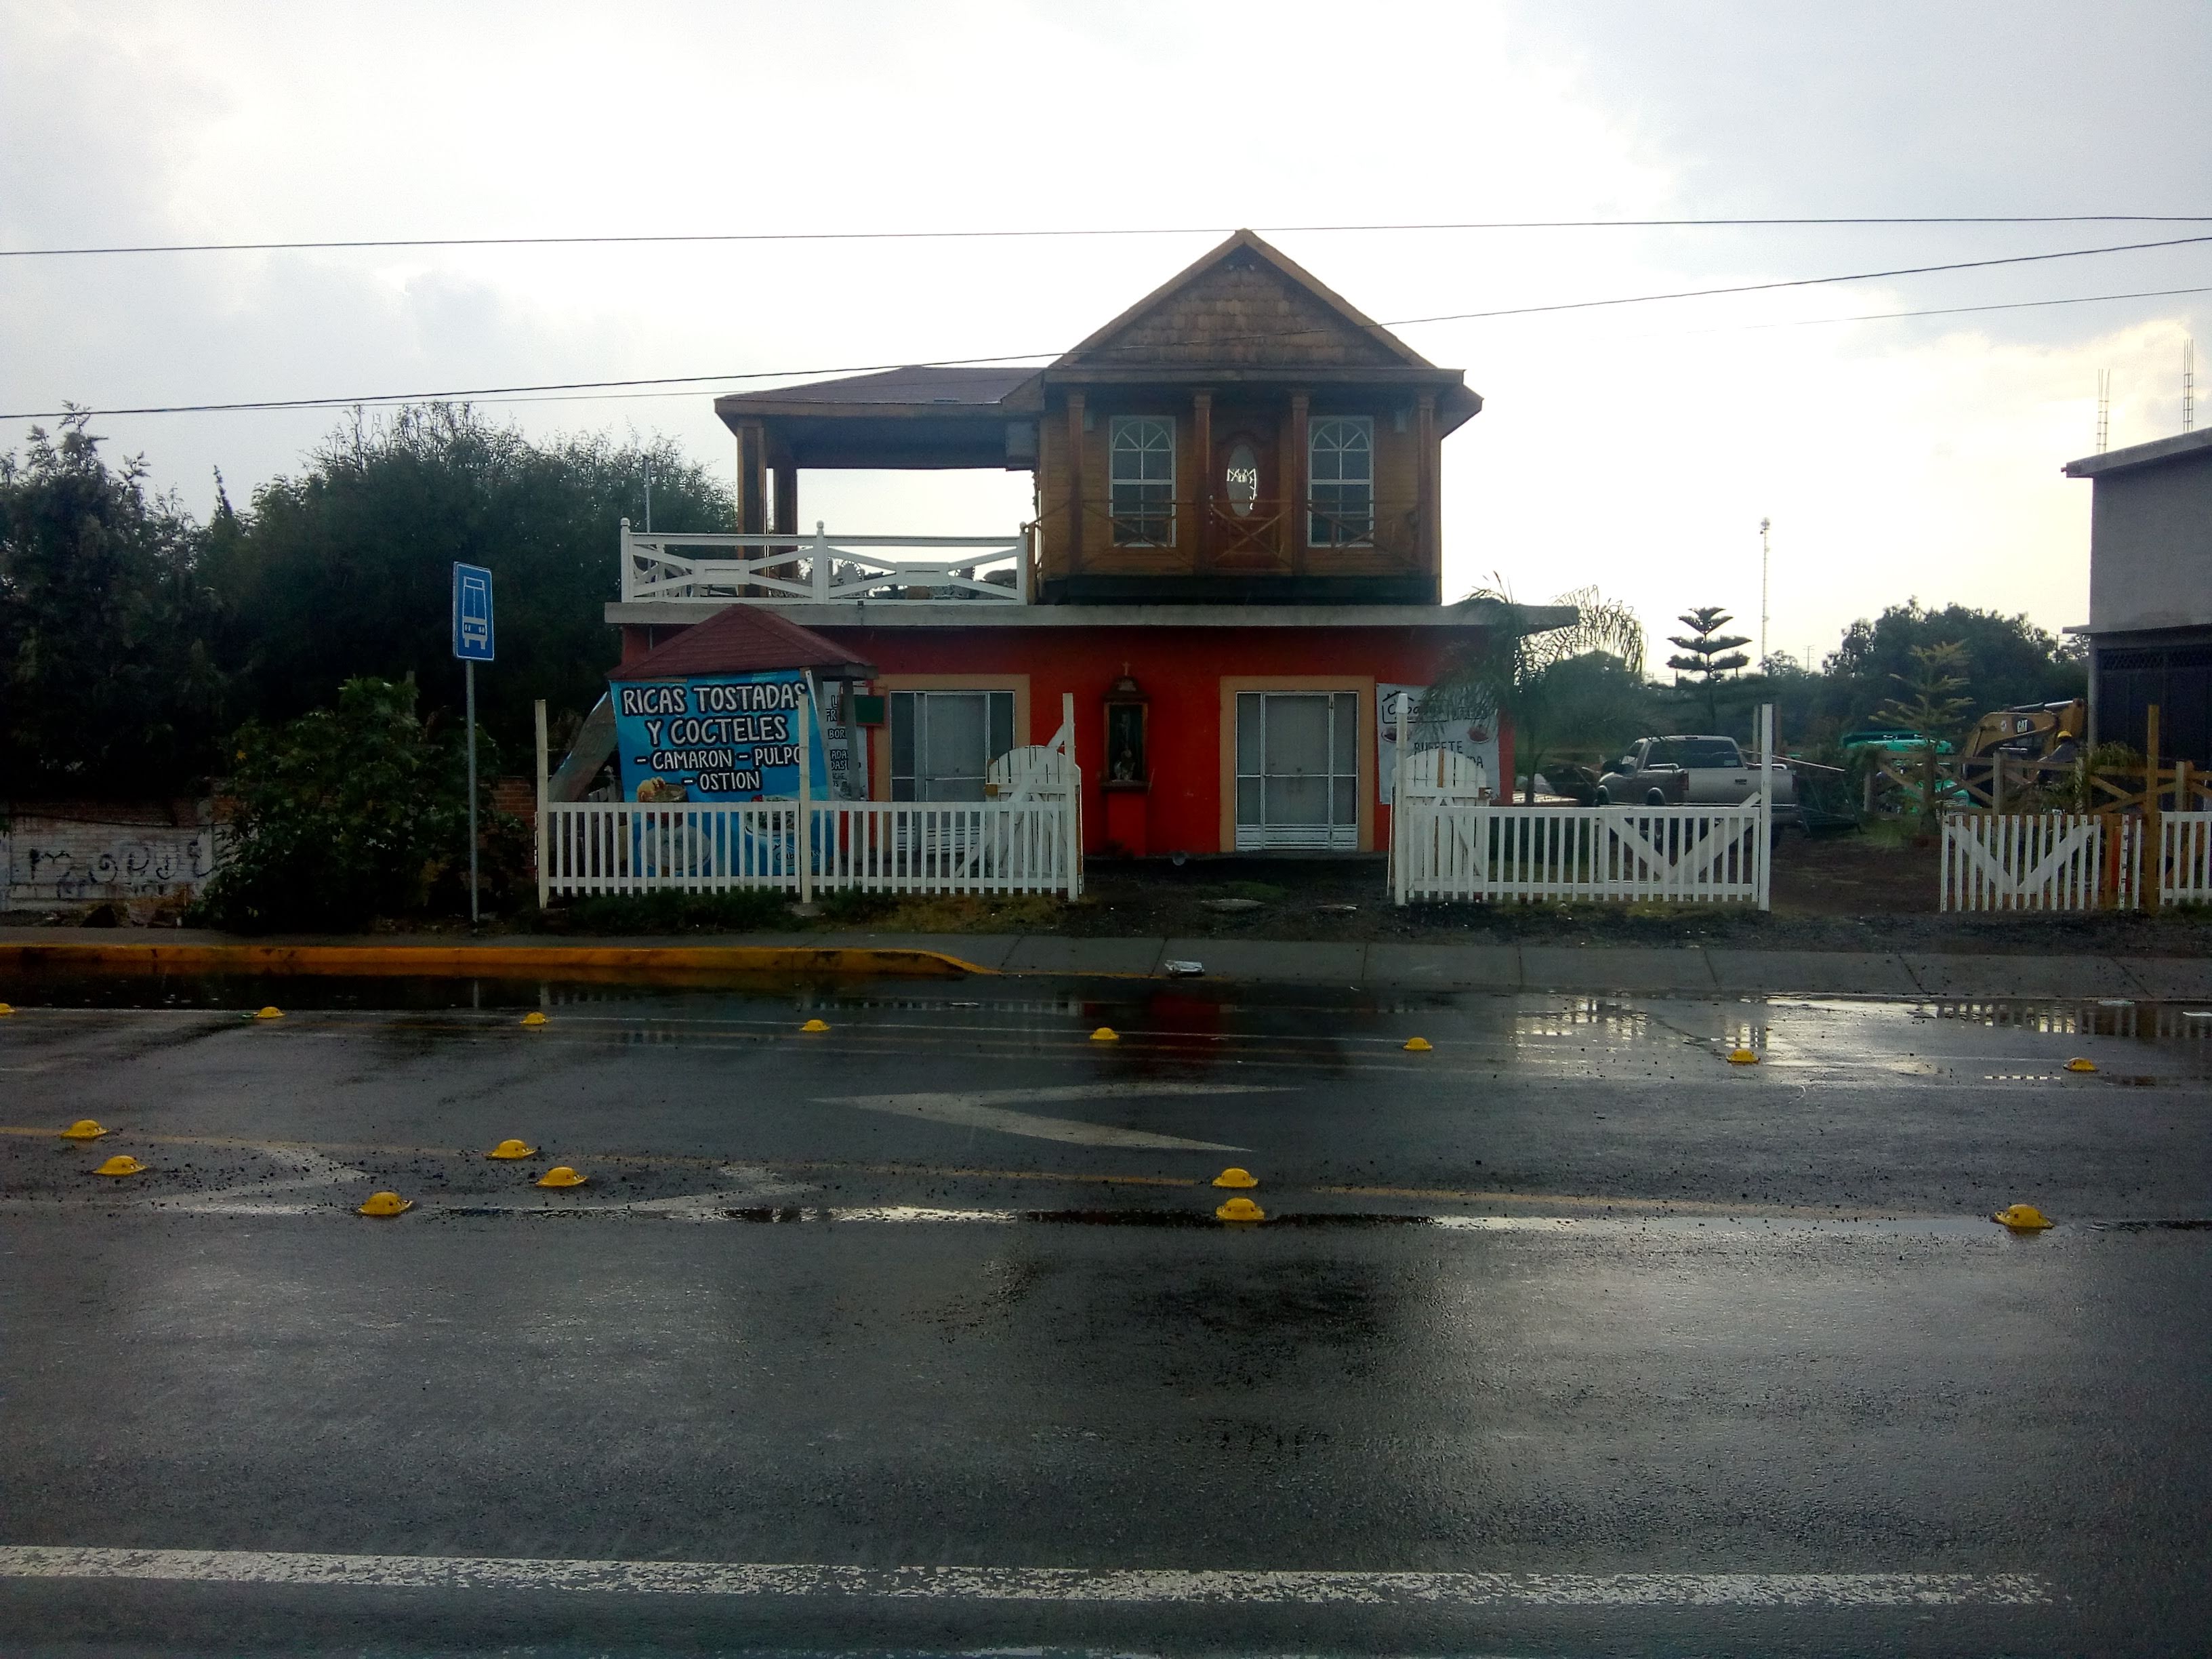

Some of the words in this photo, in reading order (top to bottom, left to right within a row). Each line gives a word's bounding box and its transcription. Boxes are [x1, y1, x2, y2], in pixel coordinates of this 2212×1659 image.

[622, 687, 686, 715] RICAS
[646, 720, 662, 745] Y
[670, 715, 788, 745] COCTELES
[651, 748, 733, 771] CAMARON
[699, 771, 760, 792] OSTION
